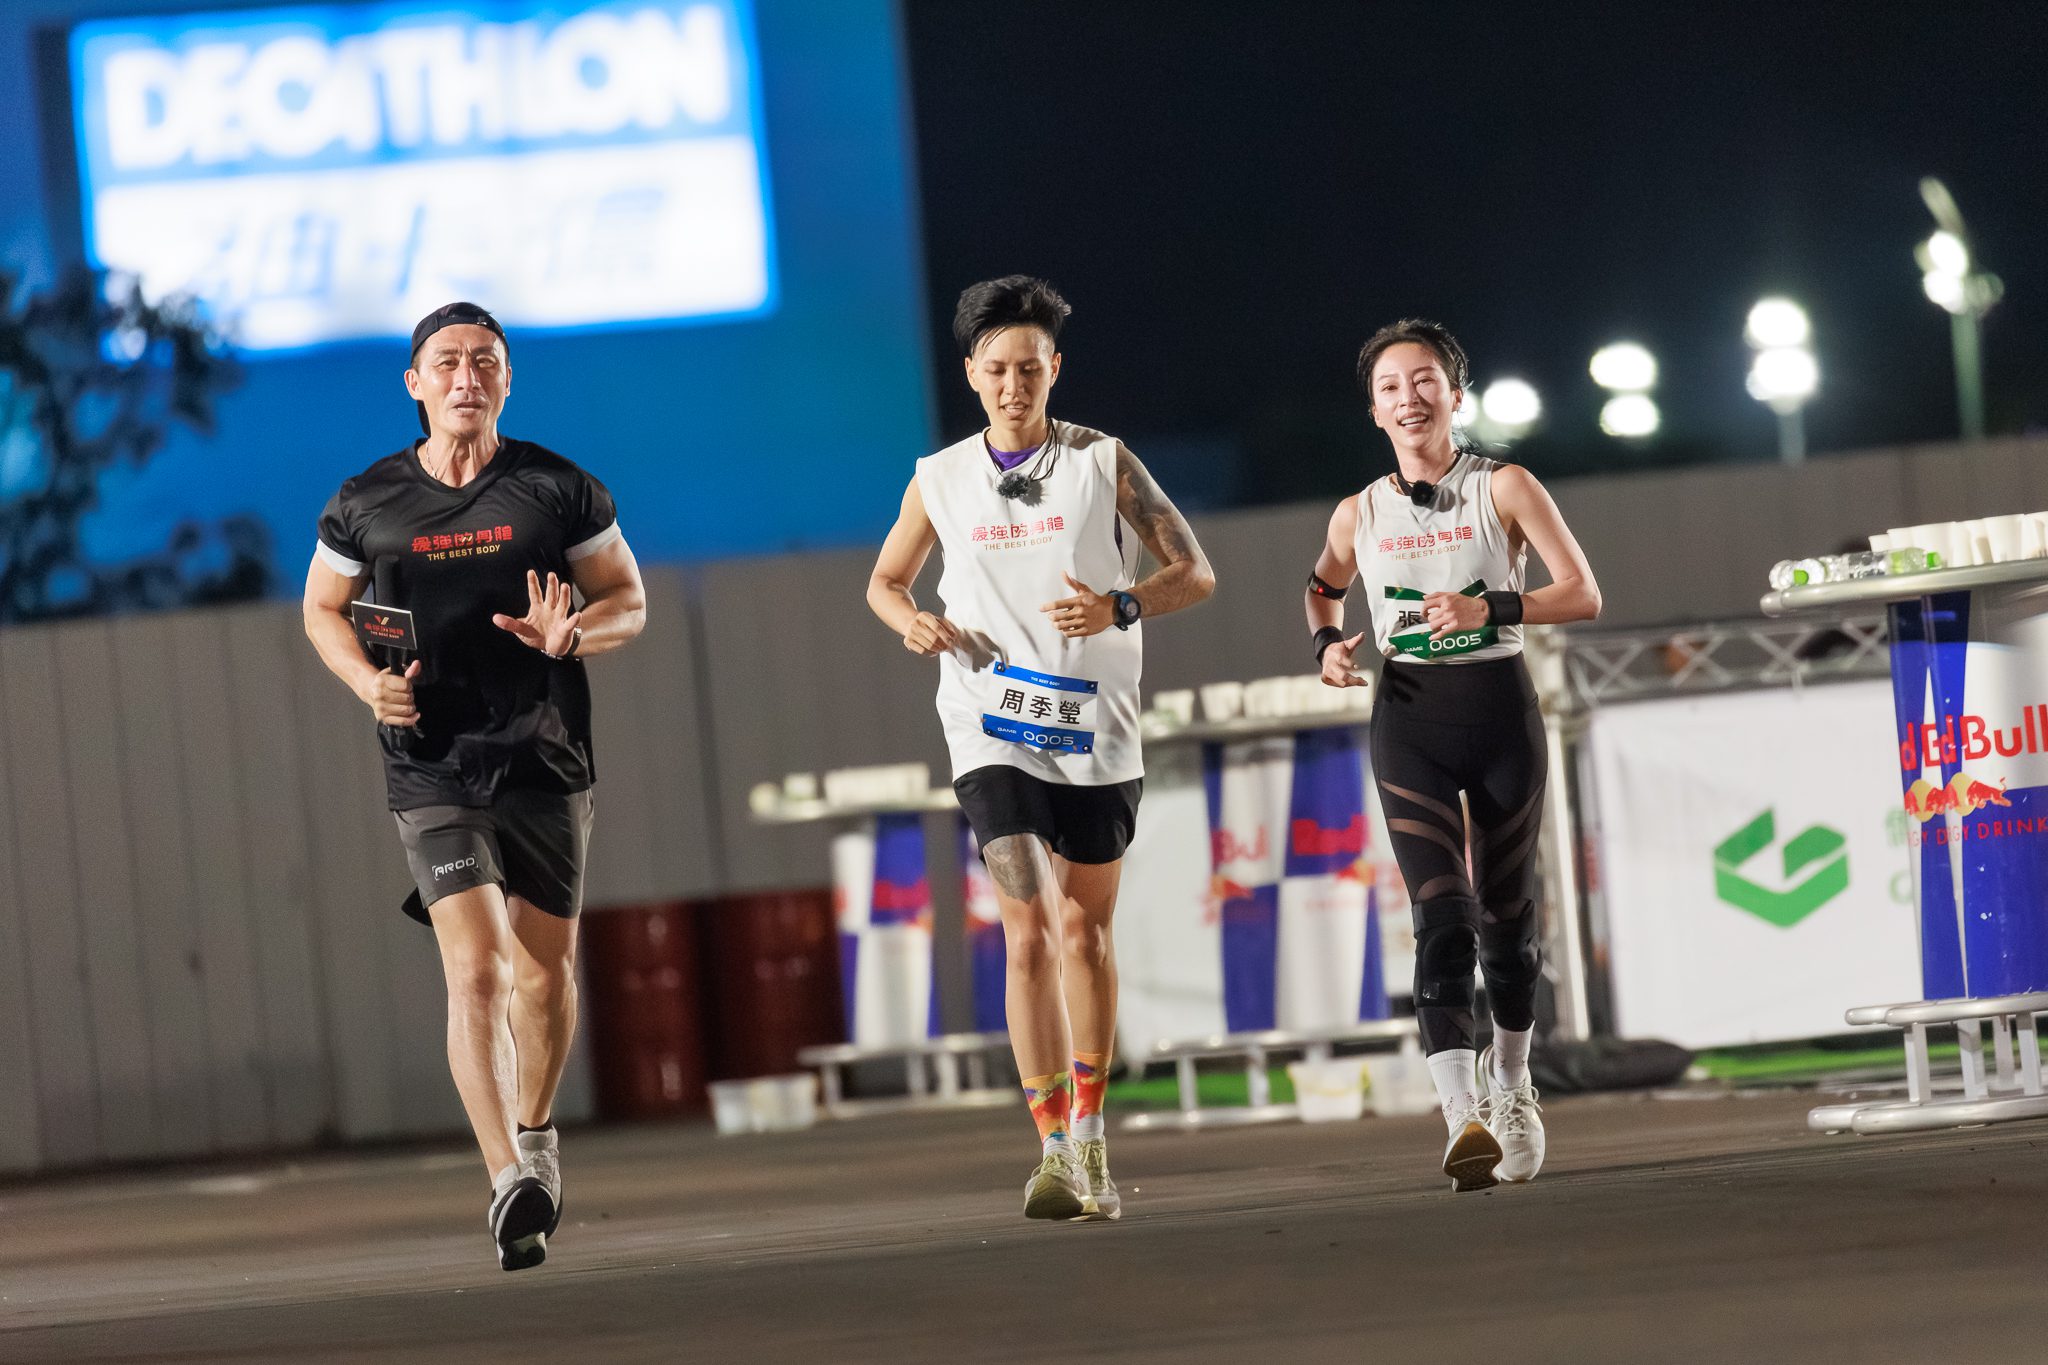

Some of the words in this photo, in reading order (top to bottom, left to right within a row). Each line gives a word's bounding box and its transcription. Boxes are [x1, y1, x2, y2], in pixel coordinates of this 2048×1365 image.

[104, 6, 730, 170] DECATHLON
[412, 525, 513, 553] 最強的身體
[984, 543, 1001, 551] THE
[1004, 540, 1027, 549] BEST
[1030, 535, 1053, 546] BODY
[427, 552, 446, 562] THE
[449, 548, 473, 559] BEST
[476, 544, 501, 555] BODY
[1391, 552, 1408, 561] THE
[1410, 549, 1434, 559] BEST
[1437, 544, 1462, 555] BODY
[1404, 645, 1424, 653] GAME
[1429, 633, 1482, 651] 0005
[999, 688, 1081, 725] 周季瑩
[997, 726, 1018, 735] GAME
[1023, 730, 1075, 746] 0005
[1959, 703, 2048, 761] Bull
[434, 857, 475, 877] AROO
